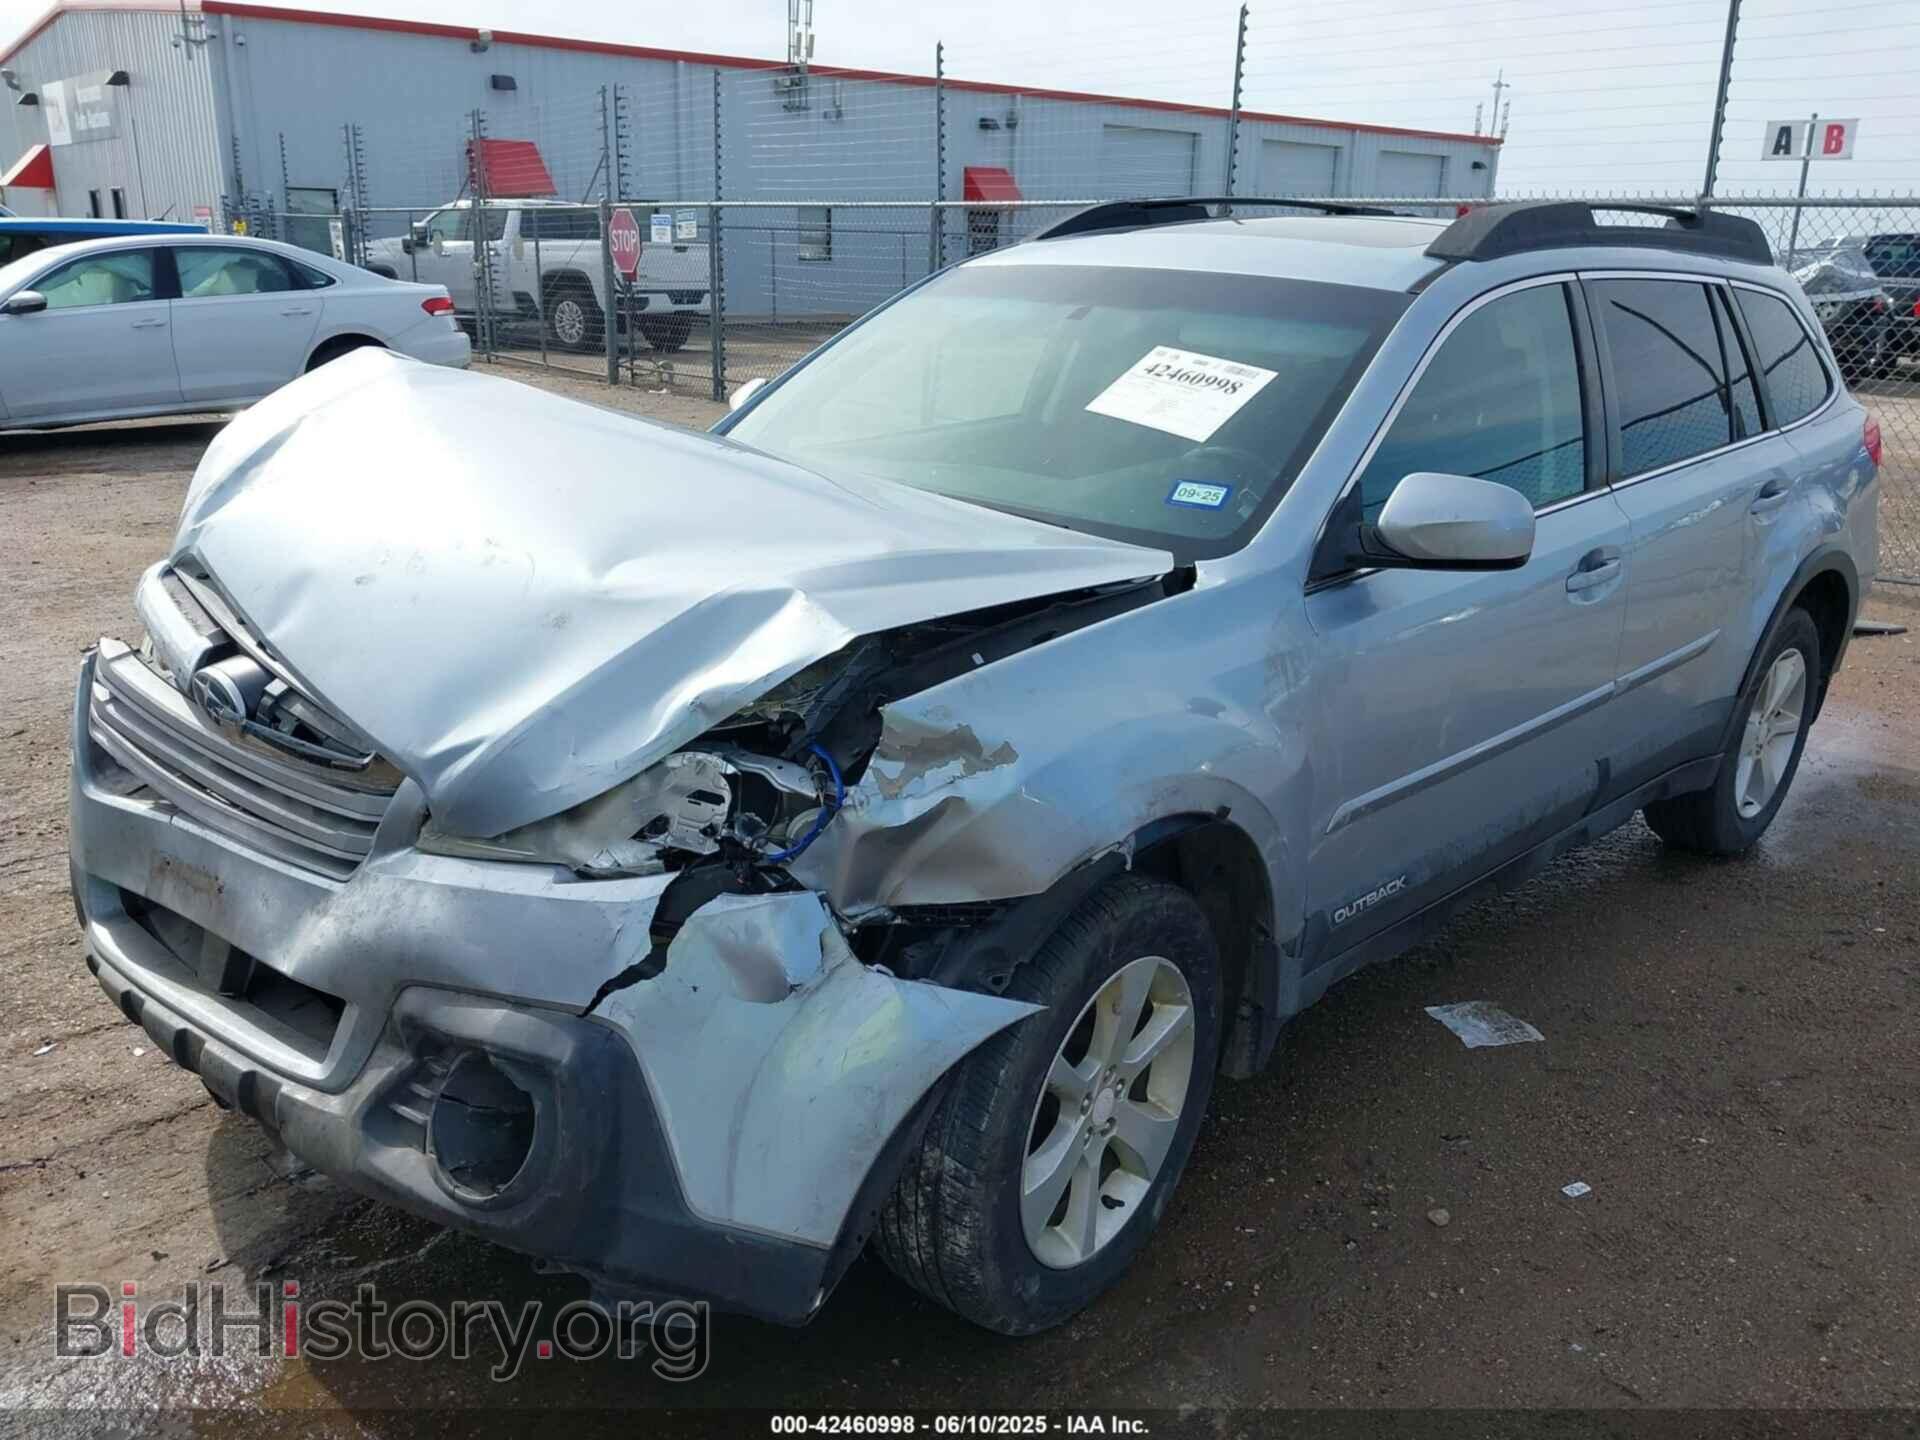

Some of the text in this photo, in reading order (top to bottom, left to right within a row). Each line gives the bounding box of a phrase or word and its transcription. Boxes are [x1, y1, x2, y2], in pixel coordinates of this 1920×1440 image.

[1772, 124, 1845, 155] A B
[612, 229, 637, 252] STOP
[1144, 362, 1243, 395] 42460998
[1334, 874, 1406, 923] OUTBACK
